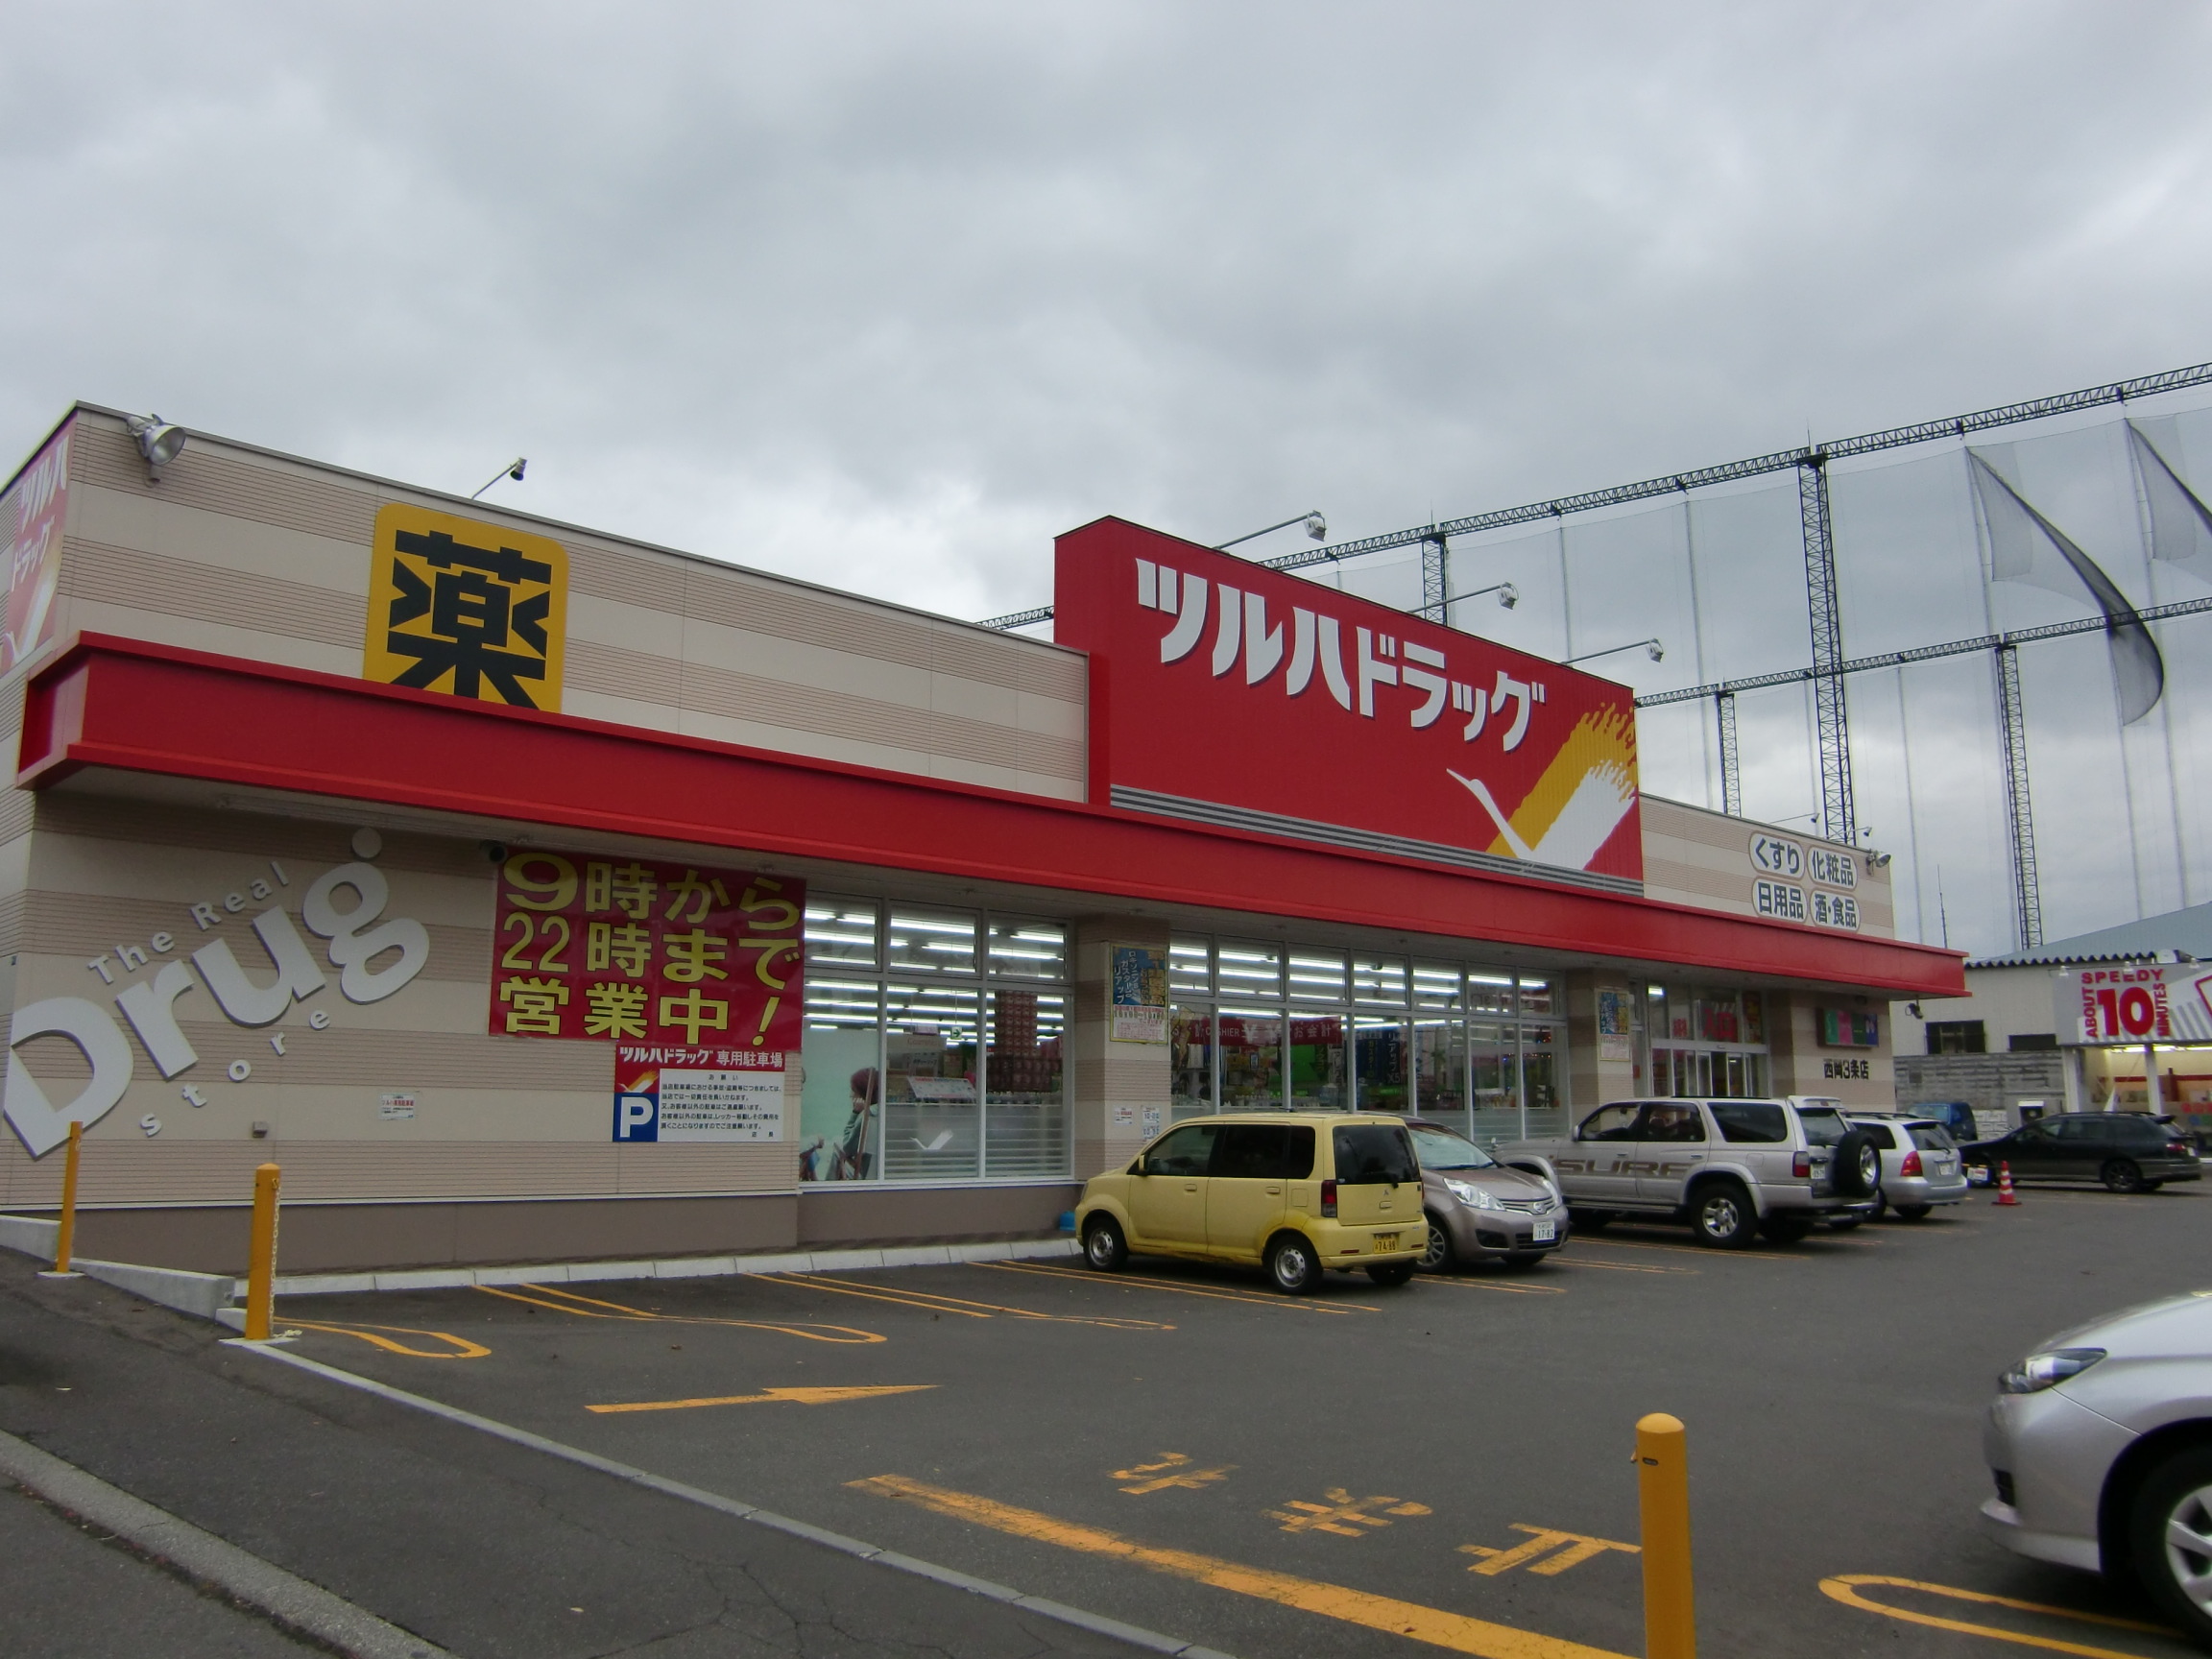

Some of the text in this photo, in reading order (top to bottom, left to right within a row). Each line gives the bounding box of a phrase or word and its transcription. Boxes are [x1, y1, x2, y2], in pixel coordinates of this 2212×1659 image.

[21, 435, 69, 534] ツルハ
[387, 530, 553, 710] 薬
[1135, 557, 1547, 753] ツルハドラッグ
[1755, 837, 1800, 875] くすり
[1812, 850, 1854, 887] 化粧品
[503, 852, 801, 931] 9時から
[1757, 881, 1804, 920] 日用品
[88, 861, 289, 985] The Real
[500, 911, 801, 991] 22時まで
[2080, 968, 2164, 985] SPEEDY
[3, 861, 430, 1162] Drug
[1206, 1027, 1240, 1037] CSHIER
[2081, 987, 2099, 1038] ABOUT
[2097, 986, 2155, 1037] 10
[2152, 983, 2172, 1037] MINUTES
[140, 1009, 330, 1138] store
[619, 1046, 783, 1068] ツルハドラッグ 専用駐車場
[1823, 1058, 1869, 1080] 西岡3条店
[619, 1096, 654, 1138] P
[1551, 1159, 1693, 1179] SURF
